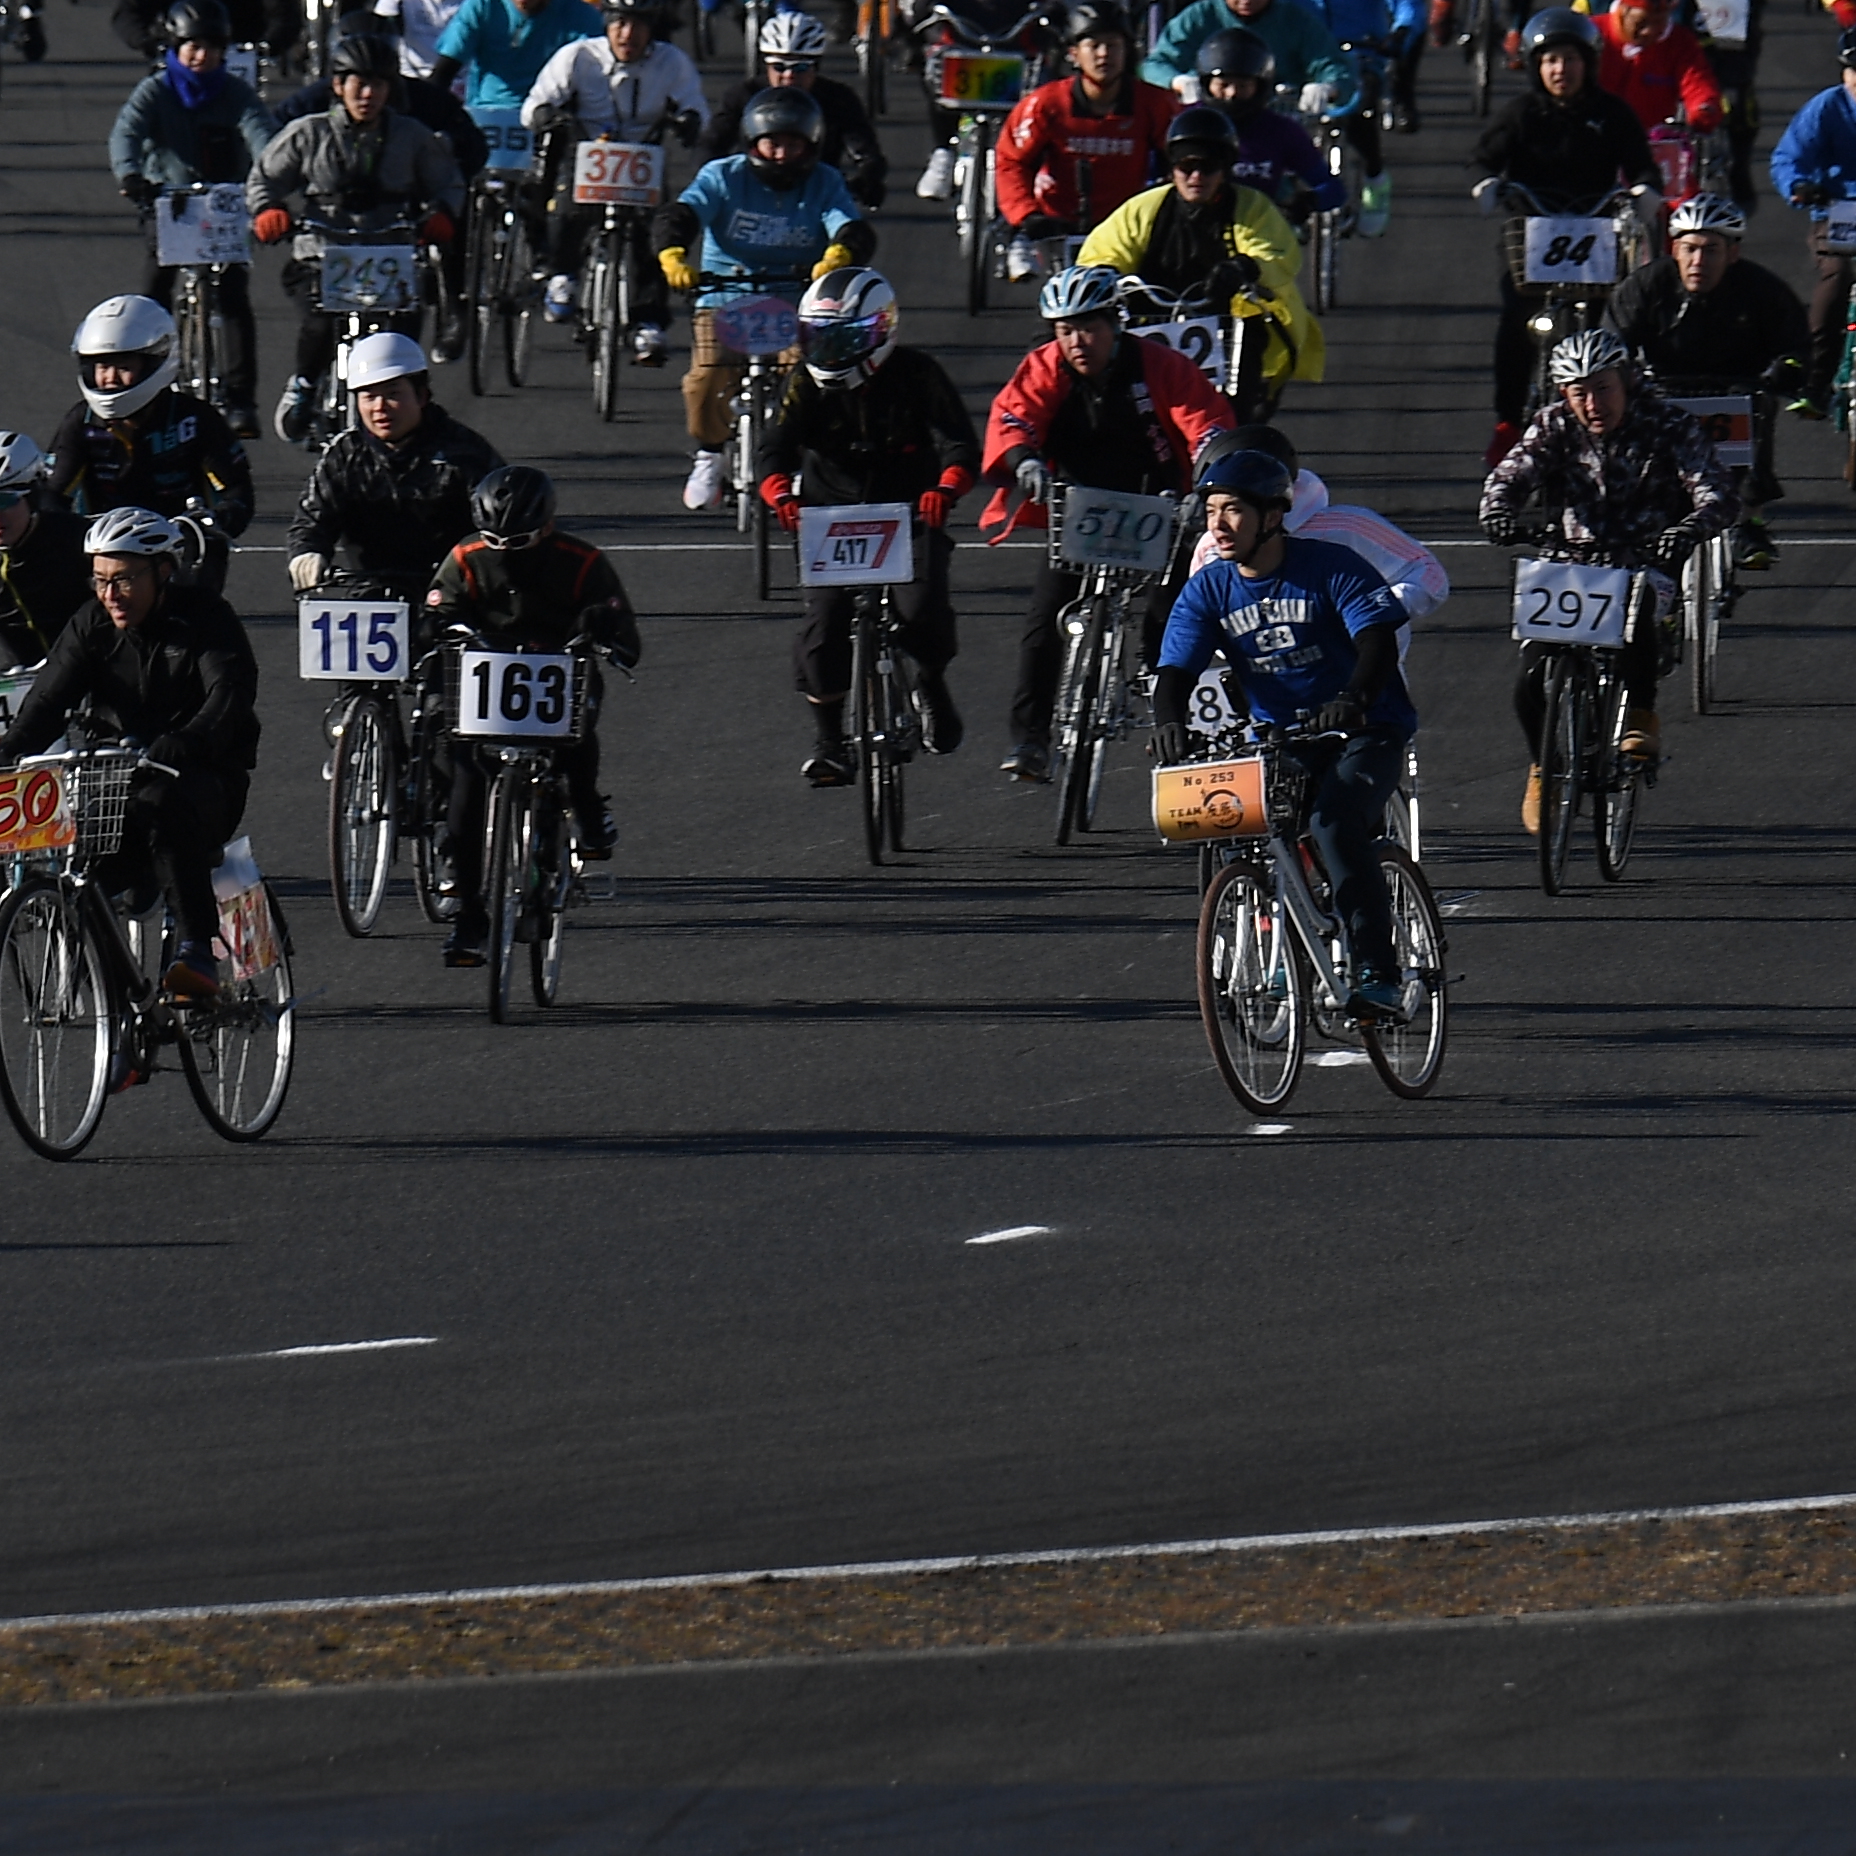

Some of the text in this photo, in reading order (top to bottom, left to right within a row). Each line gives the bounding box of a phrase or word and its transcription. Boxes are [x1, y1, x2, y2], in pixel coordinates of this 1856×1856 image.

[585, 148, 653, 187] 376
[1541, 233, 1597, 267] 84
[1076, 504, 1164, 544] 510
[832, 538, 869, 566] 417
[1529, 586, 1613, 632] 297
[310, 610, 398, 674] 115
[470, 659, 566, 725] 163
[1209, 771, 1235, 784] 253
